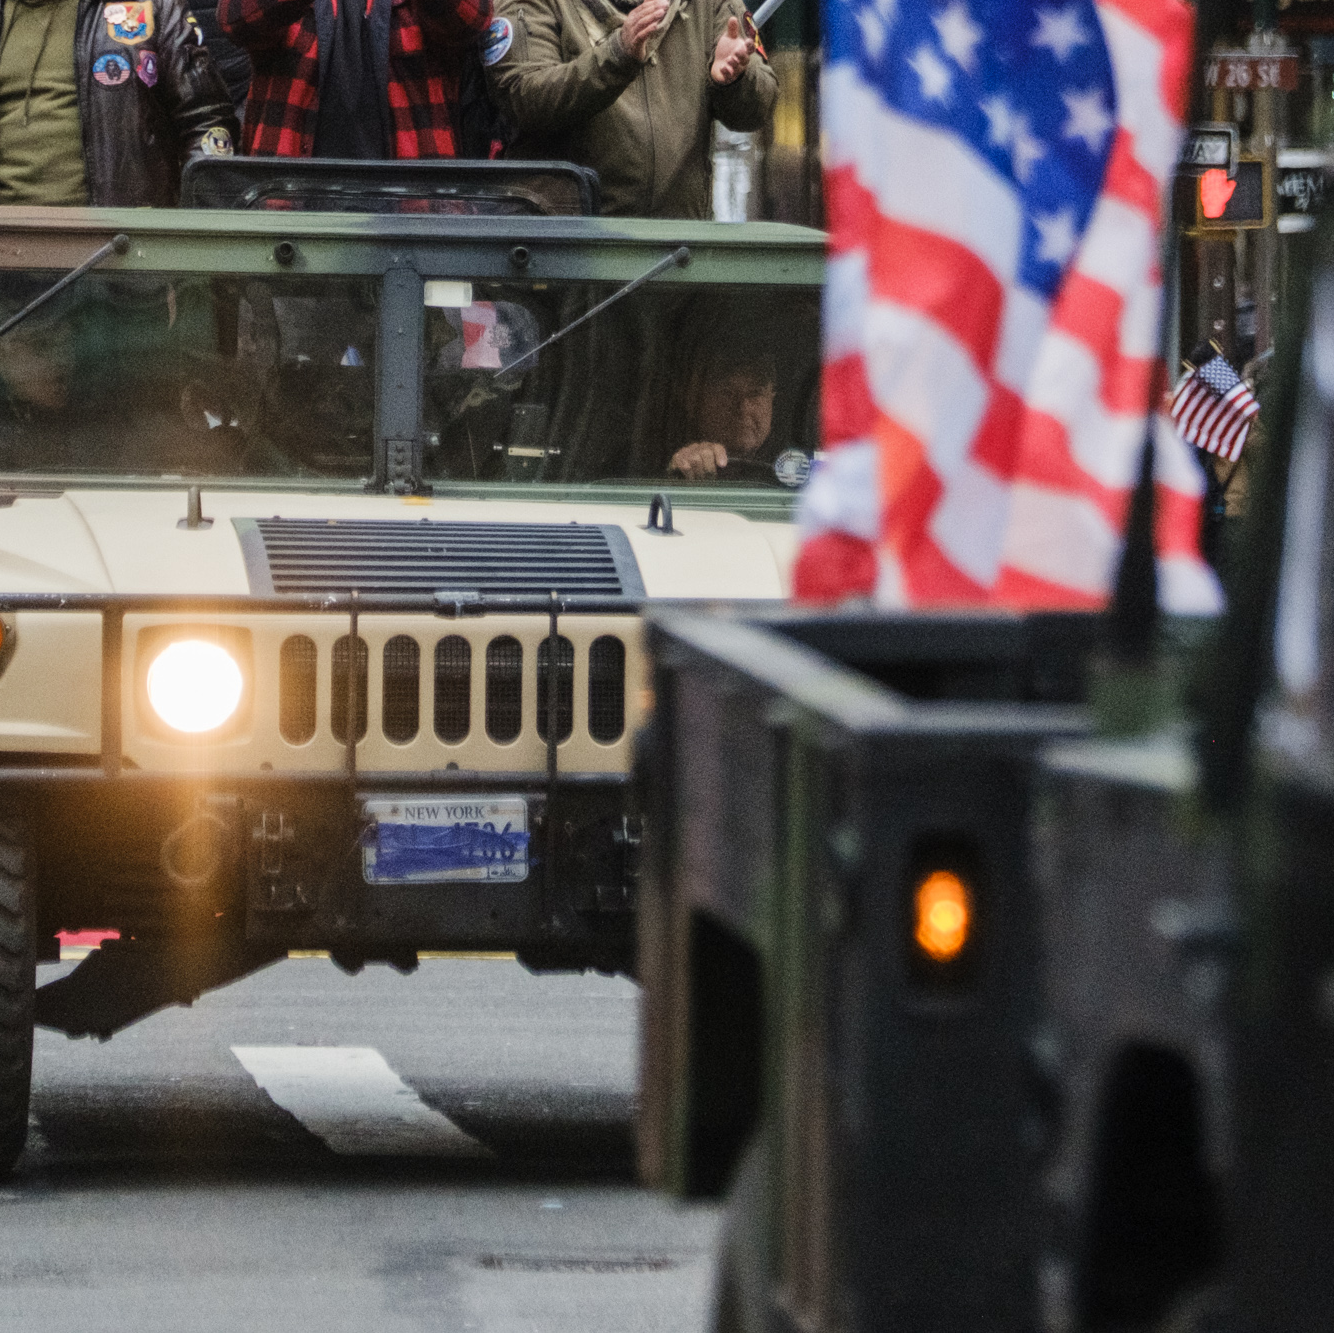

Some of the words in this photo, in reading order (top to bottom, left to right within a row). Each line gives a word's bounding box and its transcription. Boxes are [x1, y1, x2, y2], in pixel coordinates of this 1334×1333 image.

[1225, 61, 1252, 87] 26
[404, 806, 439, 820] NEW
[443, 805, 486, 819] YORK
